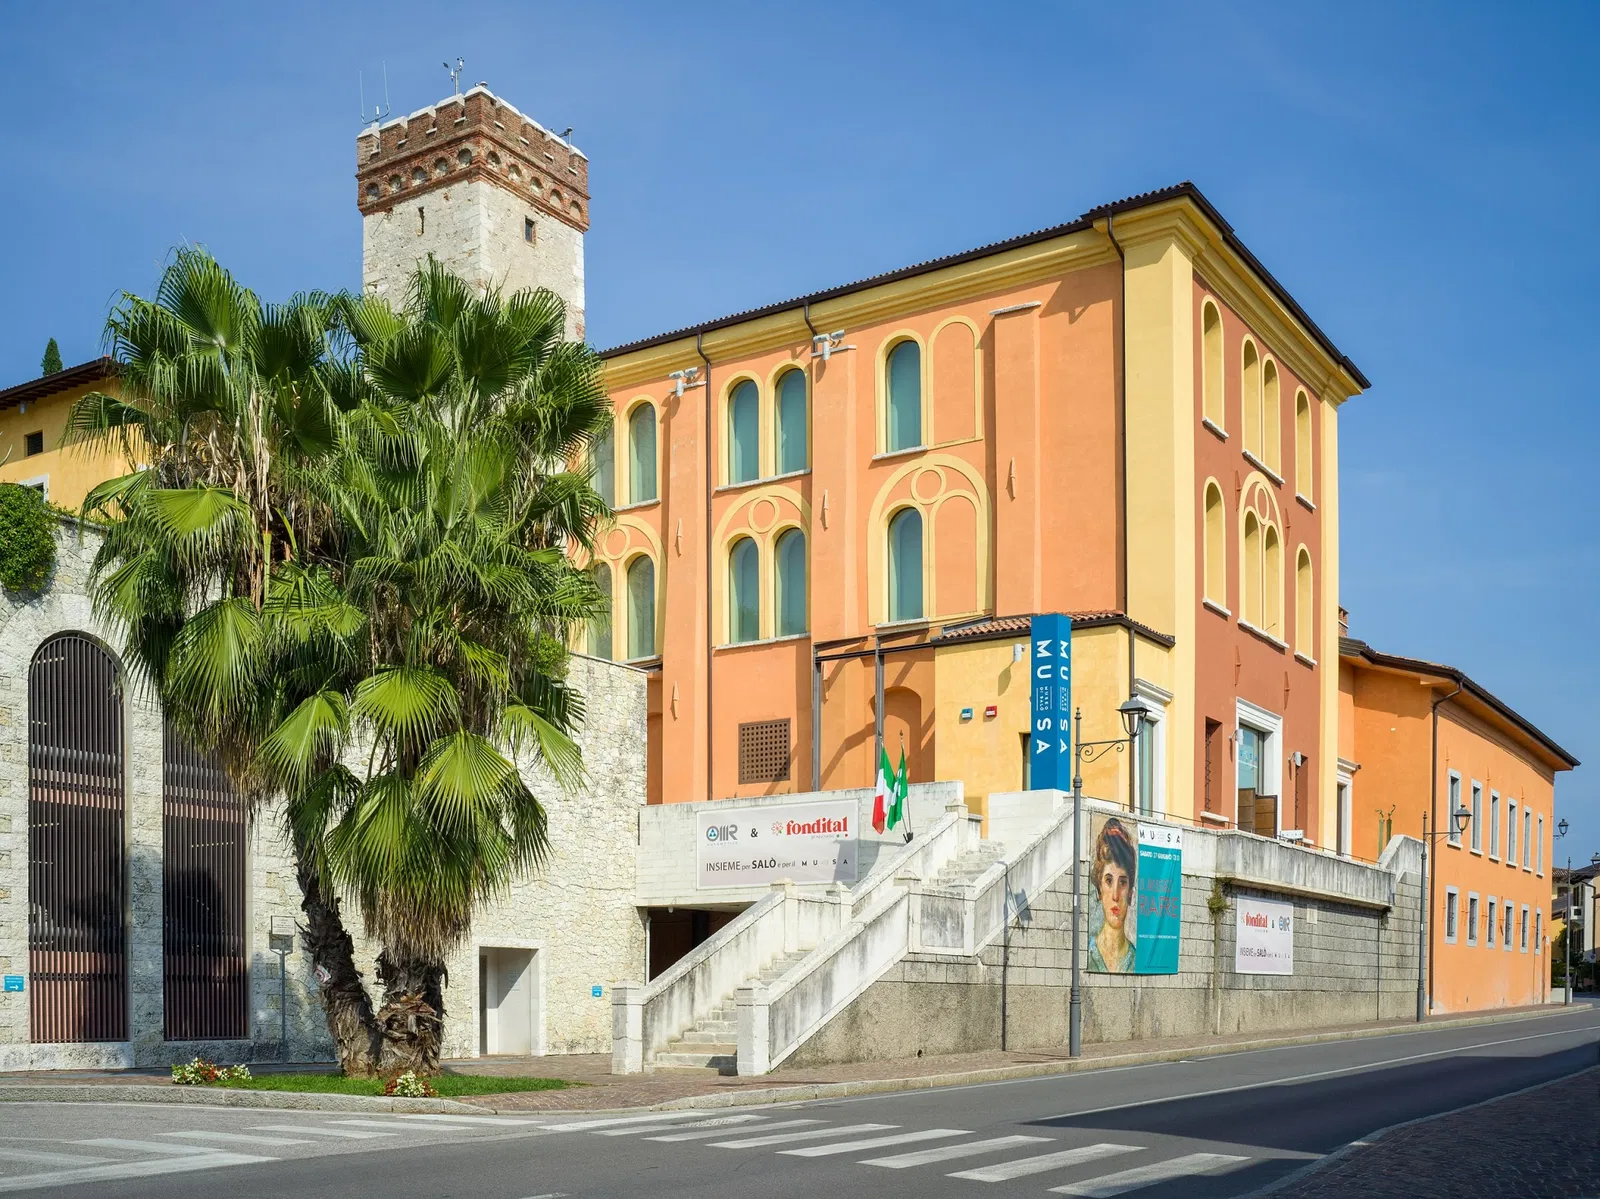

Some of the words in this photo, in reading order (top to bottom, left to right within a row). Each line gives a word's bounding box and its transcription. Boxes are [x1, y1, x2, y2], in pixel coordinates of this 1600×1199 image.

[750, 827, 758, 838] &
[786, 816, 848, 836] fondital
[706, 860, 741, 872] INSIEME
[741, 864, 751, 872] per
[751, 857, 777, 870] SALÒ
